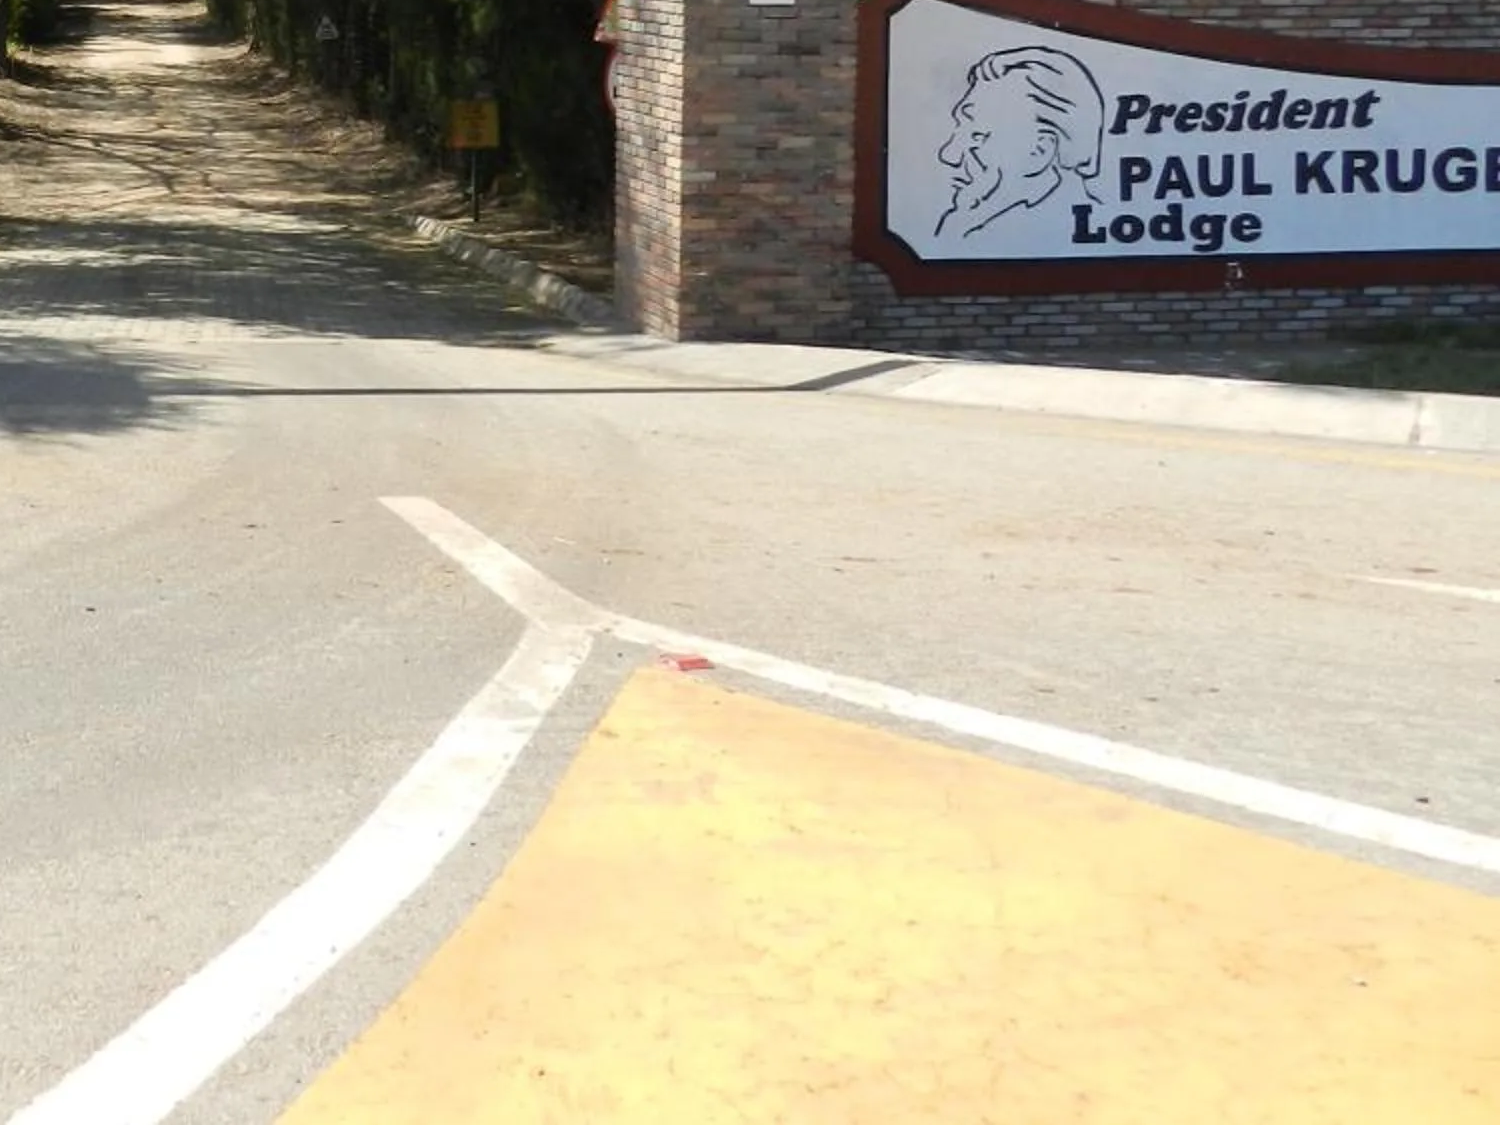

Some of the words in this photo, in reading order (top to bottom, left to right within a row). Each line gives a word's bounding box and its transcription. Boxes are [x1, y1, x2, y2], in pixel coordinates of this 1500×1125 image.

[1107, 88, 1381, 136] President
[1119, 152, 1273, 202] PAUL
[1071, 202, 1263, 254] Lodge
